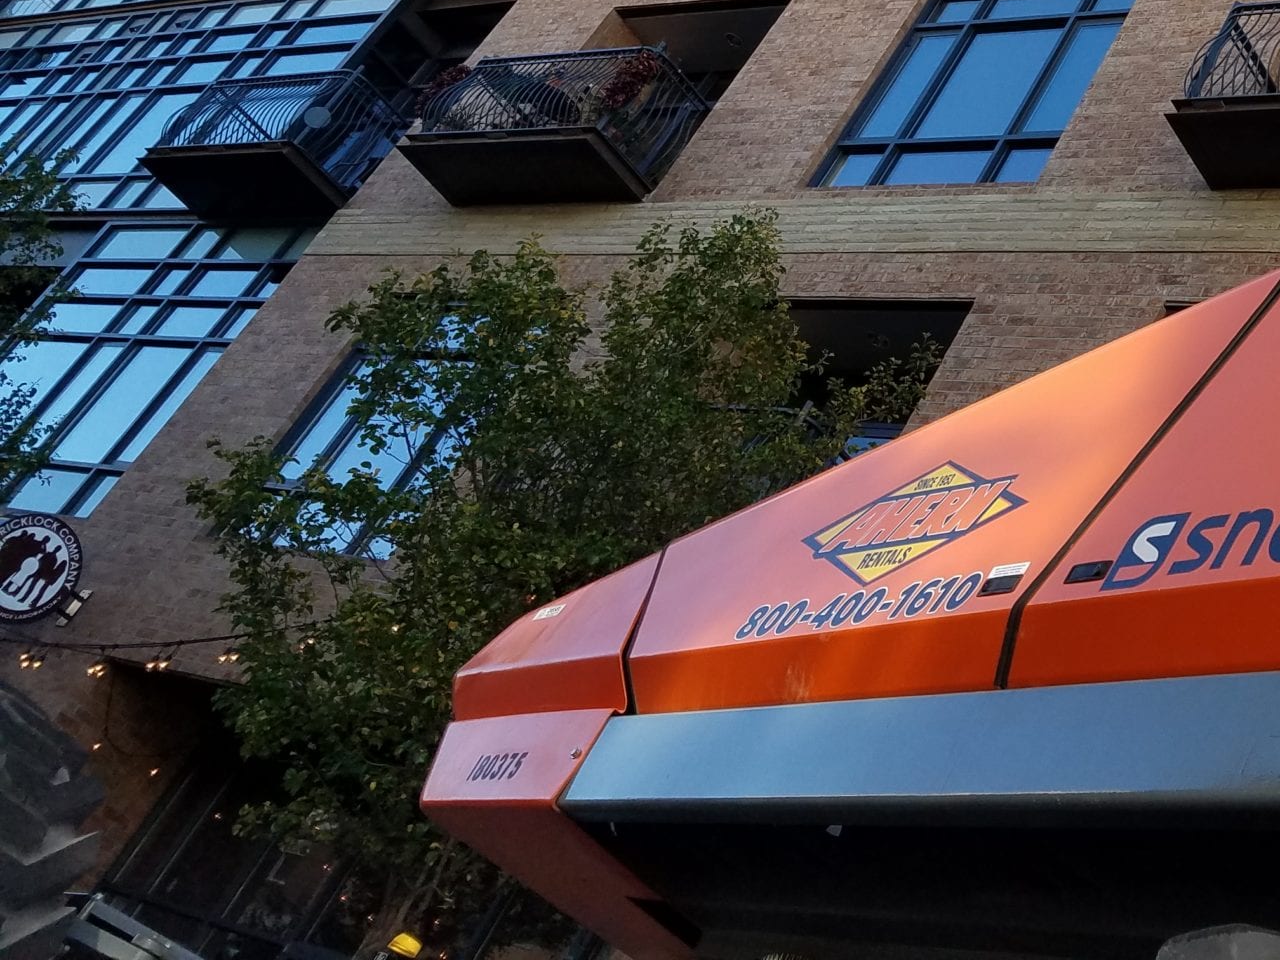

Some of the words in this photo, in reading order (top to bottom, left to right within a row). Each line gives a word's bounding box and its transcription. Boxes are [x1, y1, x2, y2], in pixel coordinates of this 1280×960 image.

[819, 478, 1014, 553] AHERN
[59, 528, 80, 591] COMPANY
[856, 546, 912, 570] RENTALS
[735, 571, 983, 641] 800-400-1610
[466, 752, 529, 781] 180375
